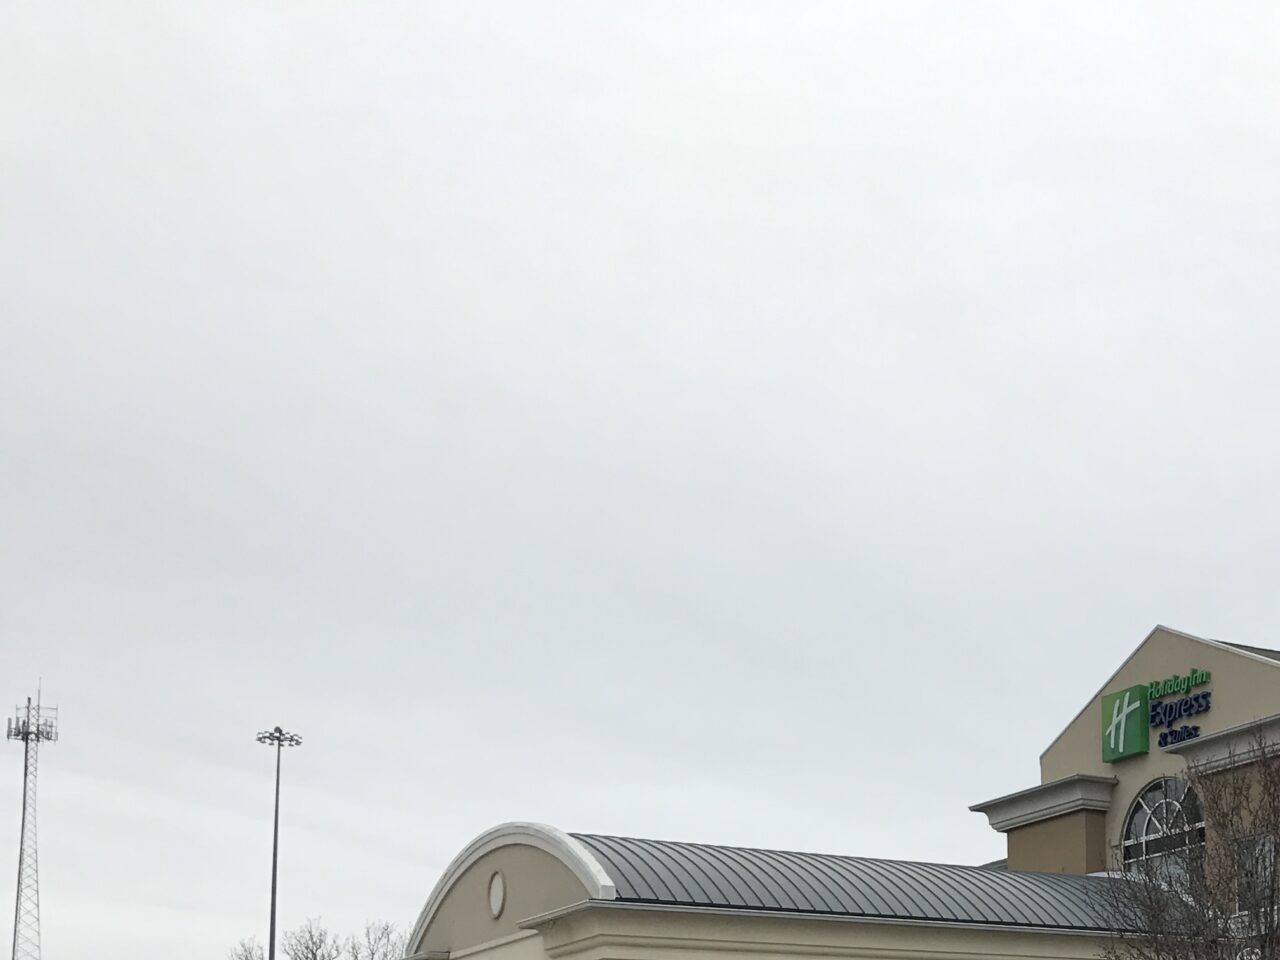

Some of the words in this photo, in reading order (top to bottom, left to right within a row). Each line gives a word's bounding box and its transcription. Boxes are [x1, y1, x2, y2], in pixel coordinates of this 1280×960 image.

[1147, 675, 1189, 700] Holiday
[1189, 668, 1210, 686] Inn
[1149, 691, 1211, 728] Express
